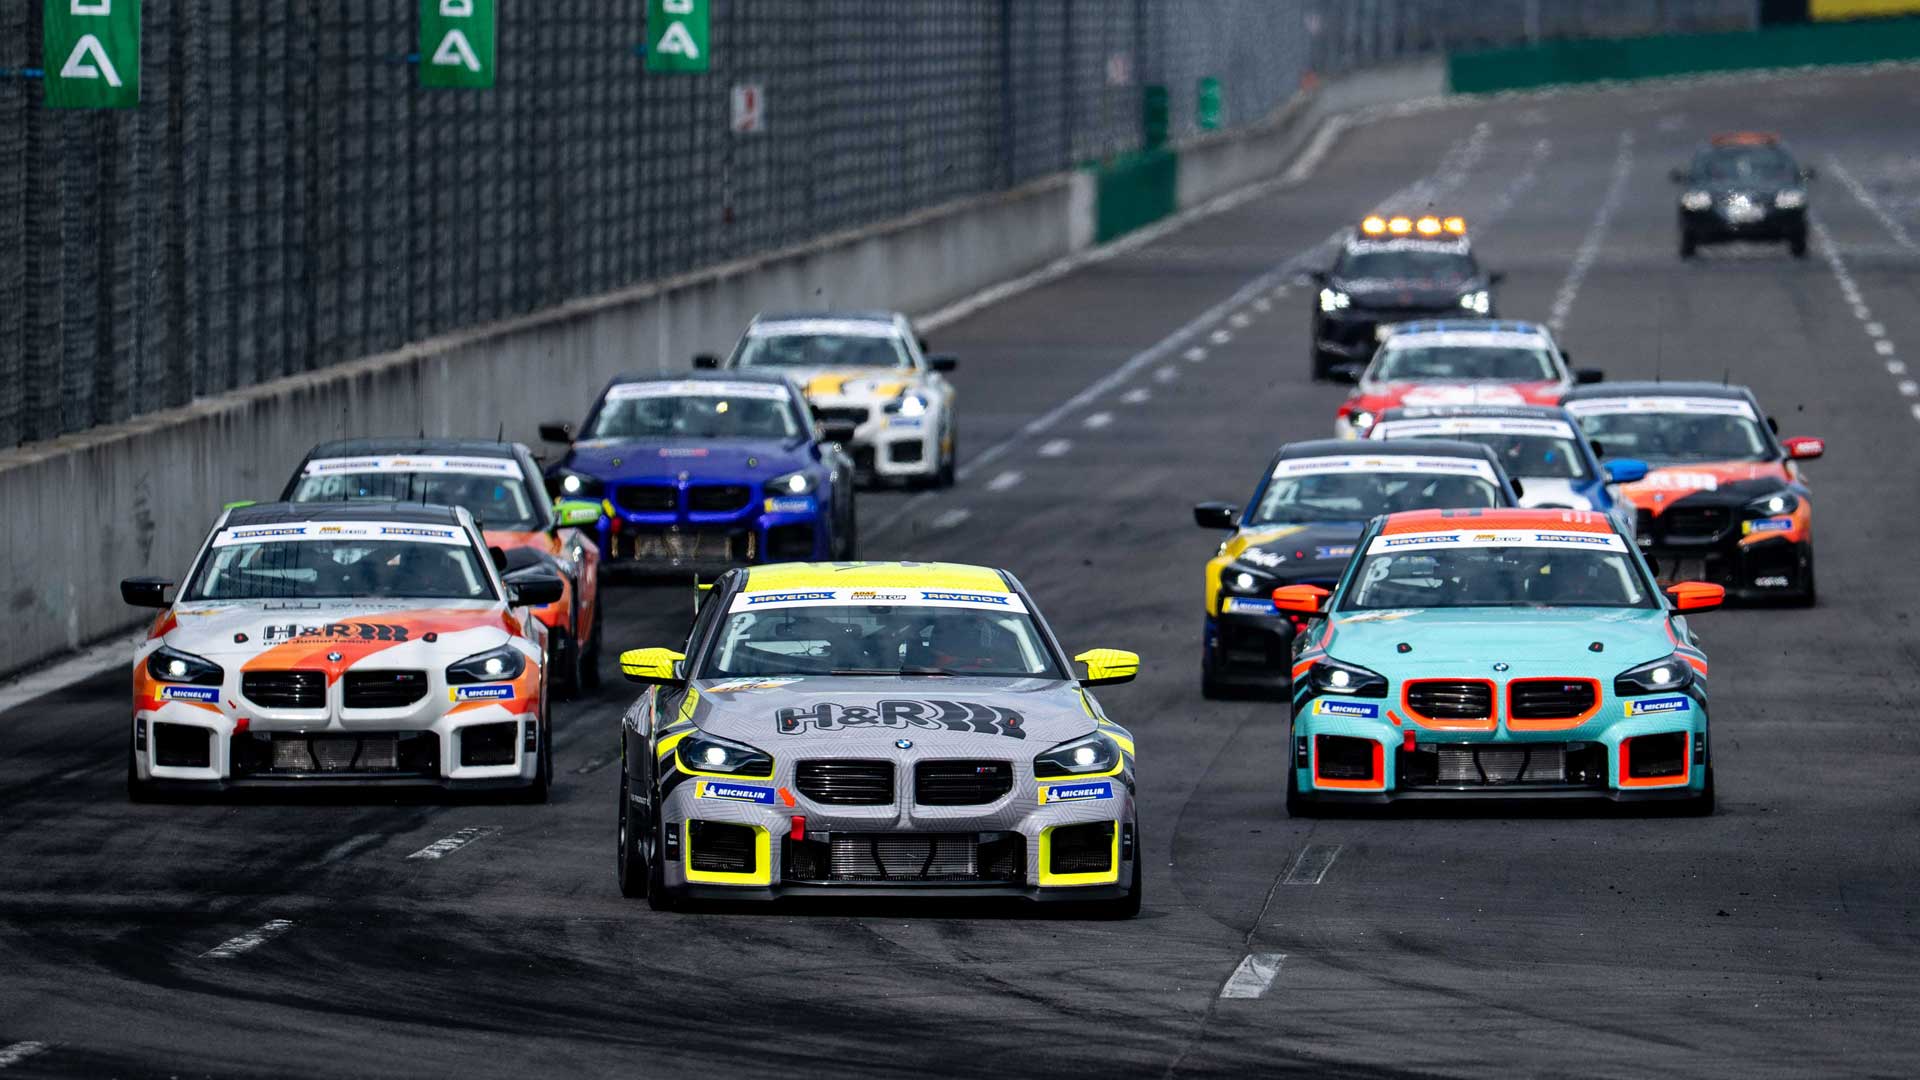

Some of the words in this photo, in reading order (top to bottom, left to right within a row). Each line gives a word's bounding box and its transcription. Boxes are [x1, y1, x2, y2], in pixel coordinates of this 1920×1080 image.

[238, 528, 301, 538] RAVENOL
[385, 527, 449, 537] RAVENOL
[1389, 535, 1454, 545] RAVENOL
[1540, 534, 1605, 544] RAVENOL
[754, 592, 830, 603] RAVENOL
[927, 592, 1004, 604] RAVENOL
[264, 623, 350, 640] H&R
[173, 690, 212, 699] MICHELIN
[468, 688, 507, 697] MICHELIN
[1331, 705, 1372, 715] MICHELIN
[1644, 701, 1683, 711] MICHELIN
[777, 699, 940, 735] H&R
[718, 788, 766, 799] MICHELIN
[1061, 787, 1104, 798] MICHELIN
